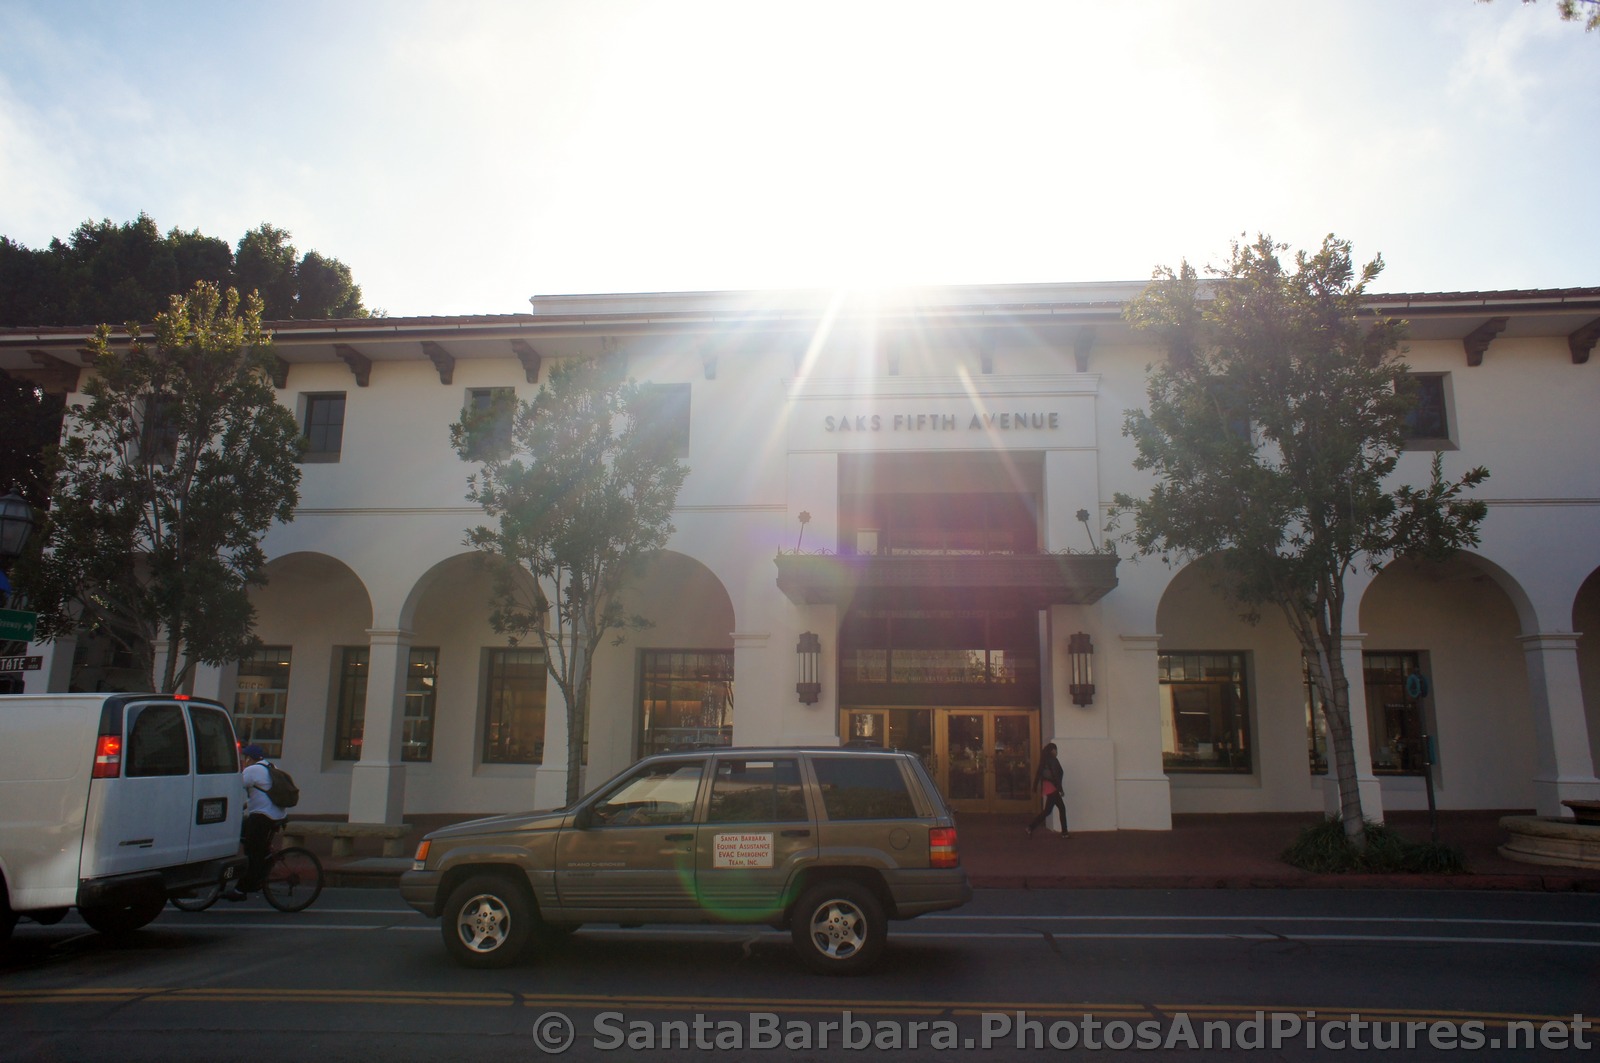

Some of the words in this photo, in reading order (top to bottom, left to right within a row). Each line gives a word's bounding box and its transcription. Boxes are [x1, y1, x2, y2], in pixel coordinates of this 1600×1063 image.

[825, 415, 881, 432] SAKS
[894, 414, 955, 431] FIFTH
[968, 412, 1059, 430] AVENUE
[0, 658, 25, 670] TATE
